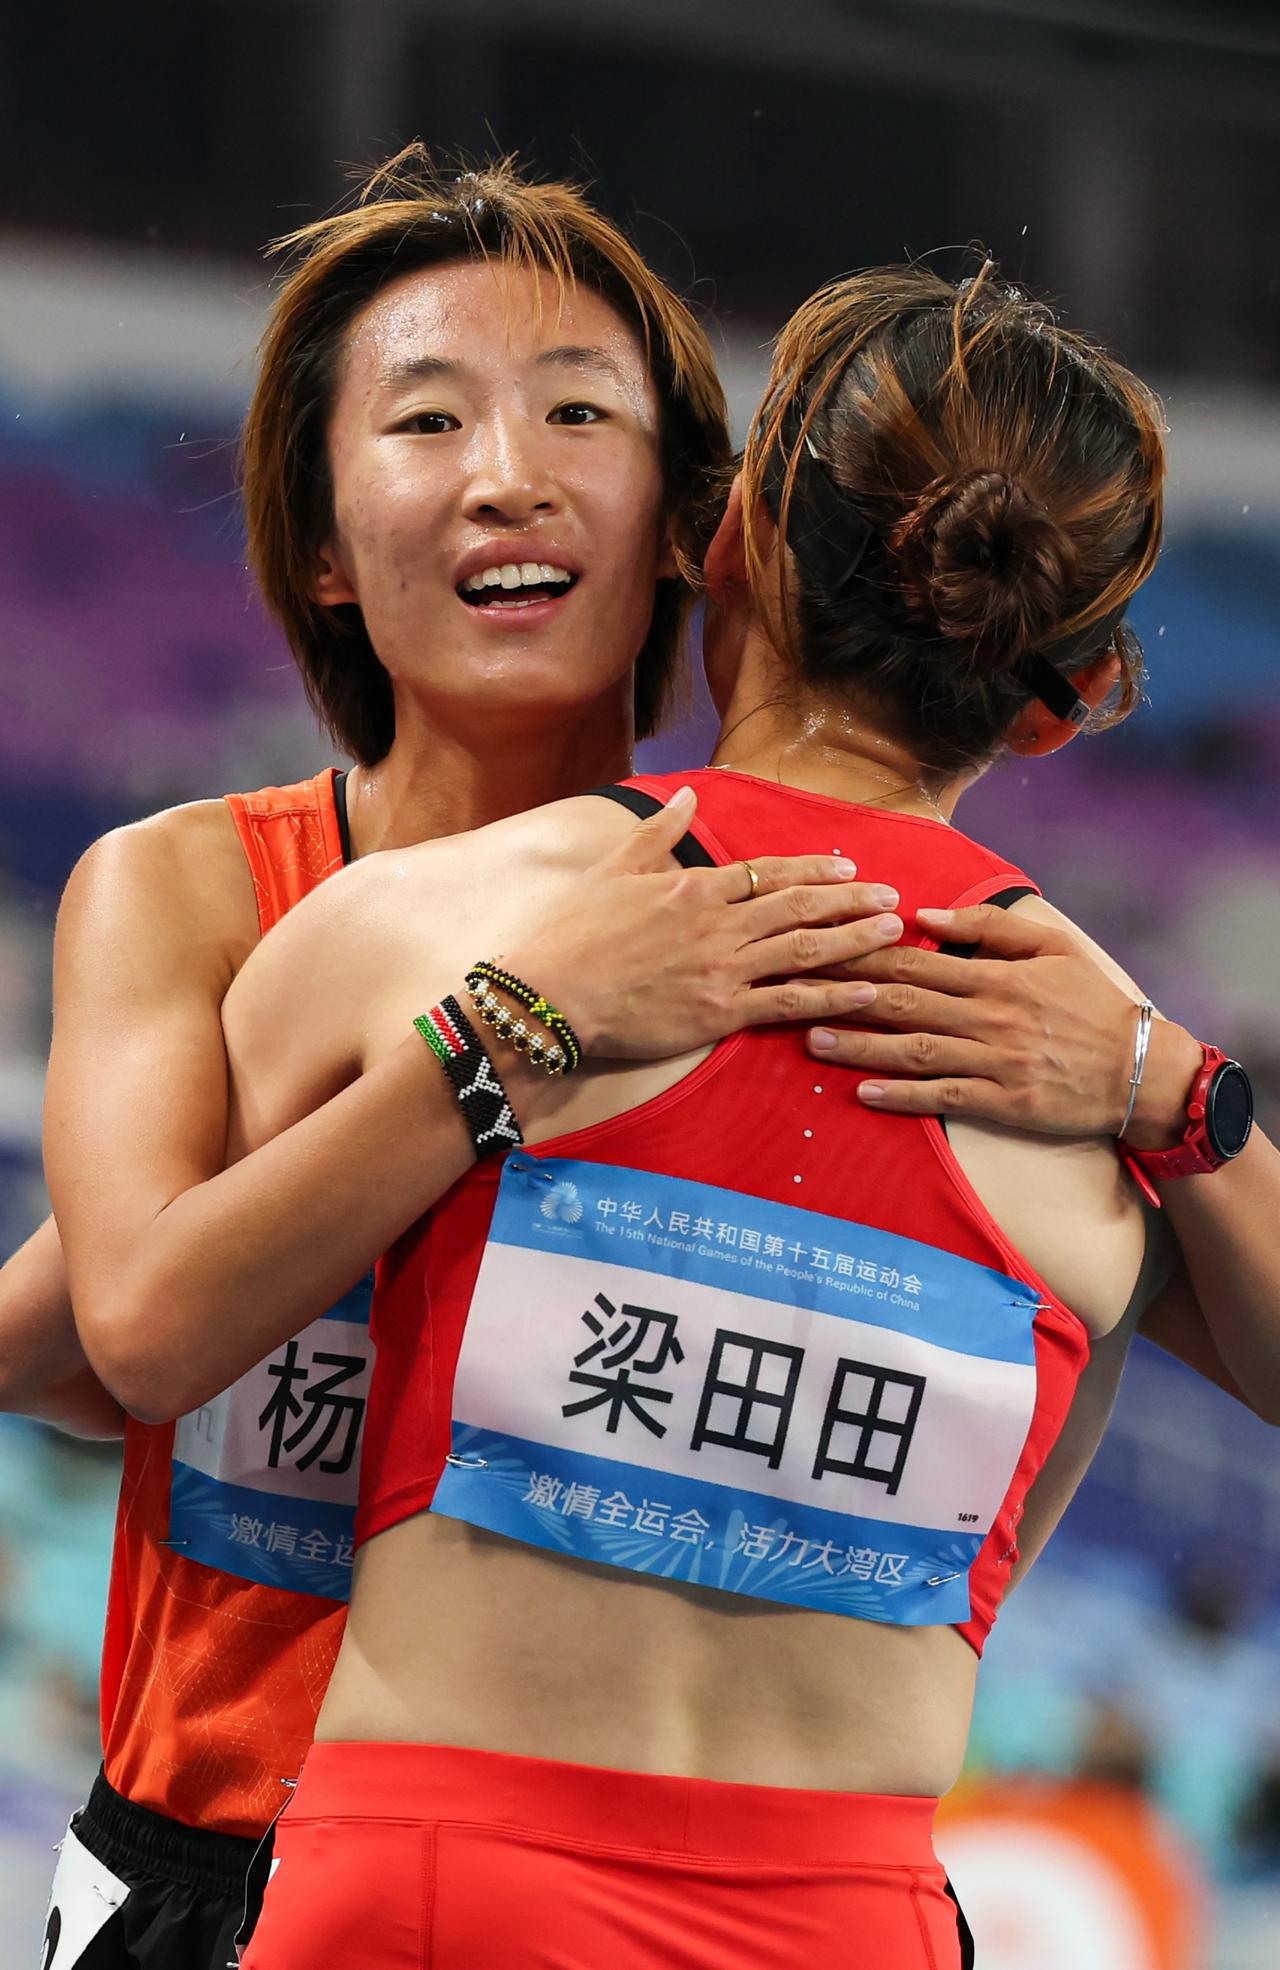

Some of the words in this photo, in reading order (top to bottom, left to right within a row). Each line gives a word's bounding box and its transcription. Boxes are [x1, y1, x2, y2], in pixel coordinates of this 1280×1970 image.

[595, 1221, 616, 1236] The
[620, 1226, 645, 1241] 15th
[647, 1233, 696, 1253] National
[698, 1244, 737, 1263] Games
[740, 1256, 753, 1267] of
[755, 1259, 774, 1273] the
[776, 1263, 823, 1285] People's
[825, 1276, 874, 1298] Republic
[876, 1291, 888, 1301] of
[890, 1293, 920, 1312] China
[597, 1197, 923, 1296] 中华人民共和国第十五届运动会
[258, 1340, 367, 1475] 杨
[561, 1292, 927, 1495] 梁田田
[957, 1512, 980, 1524] 1619
